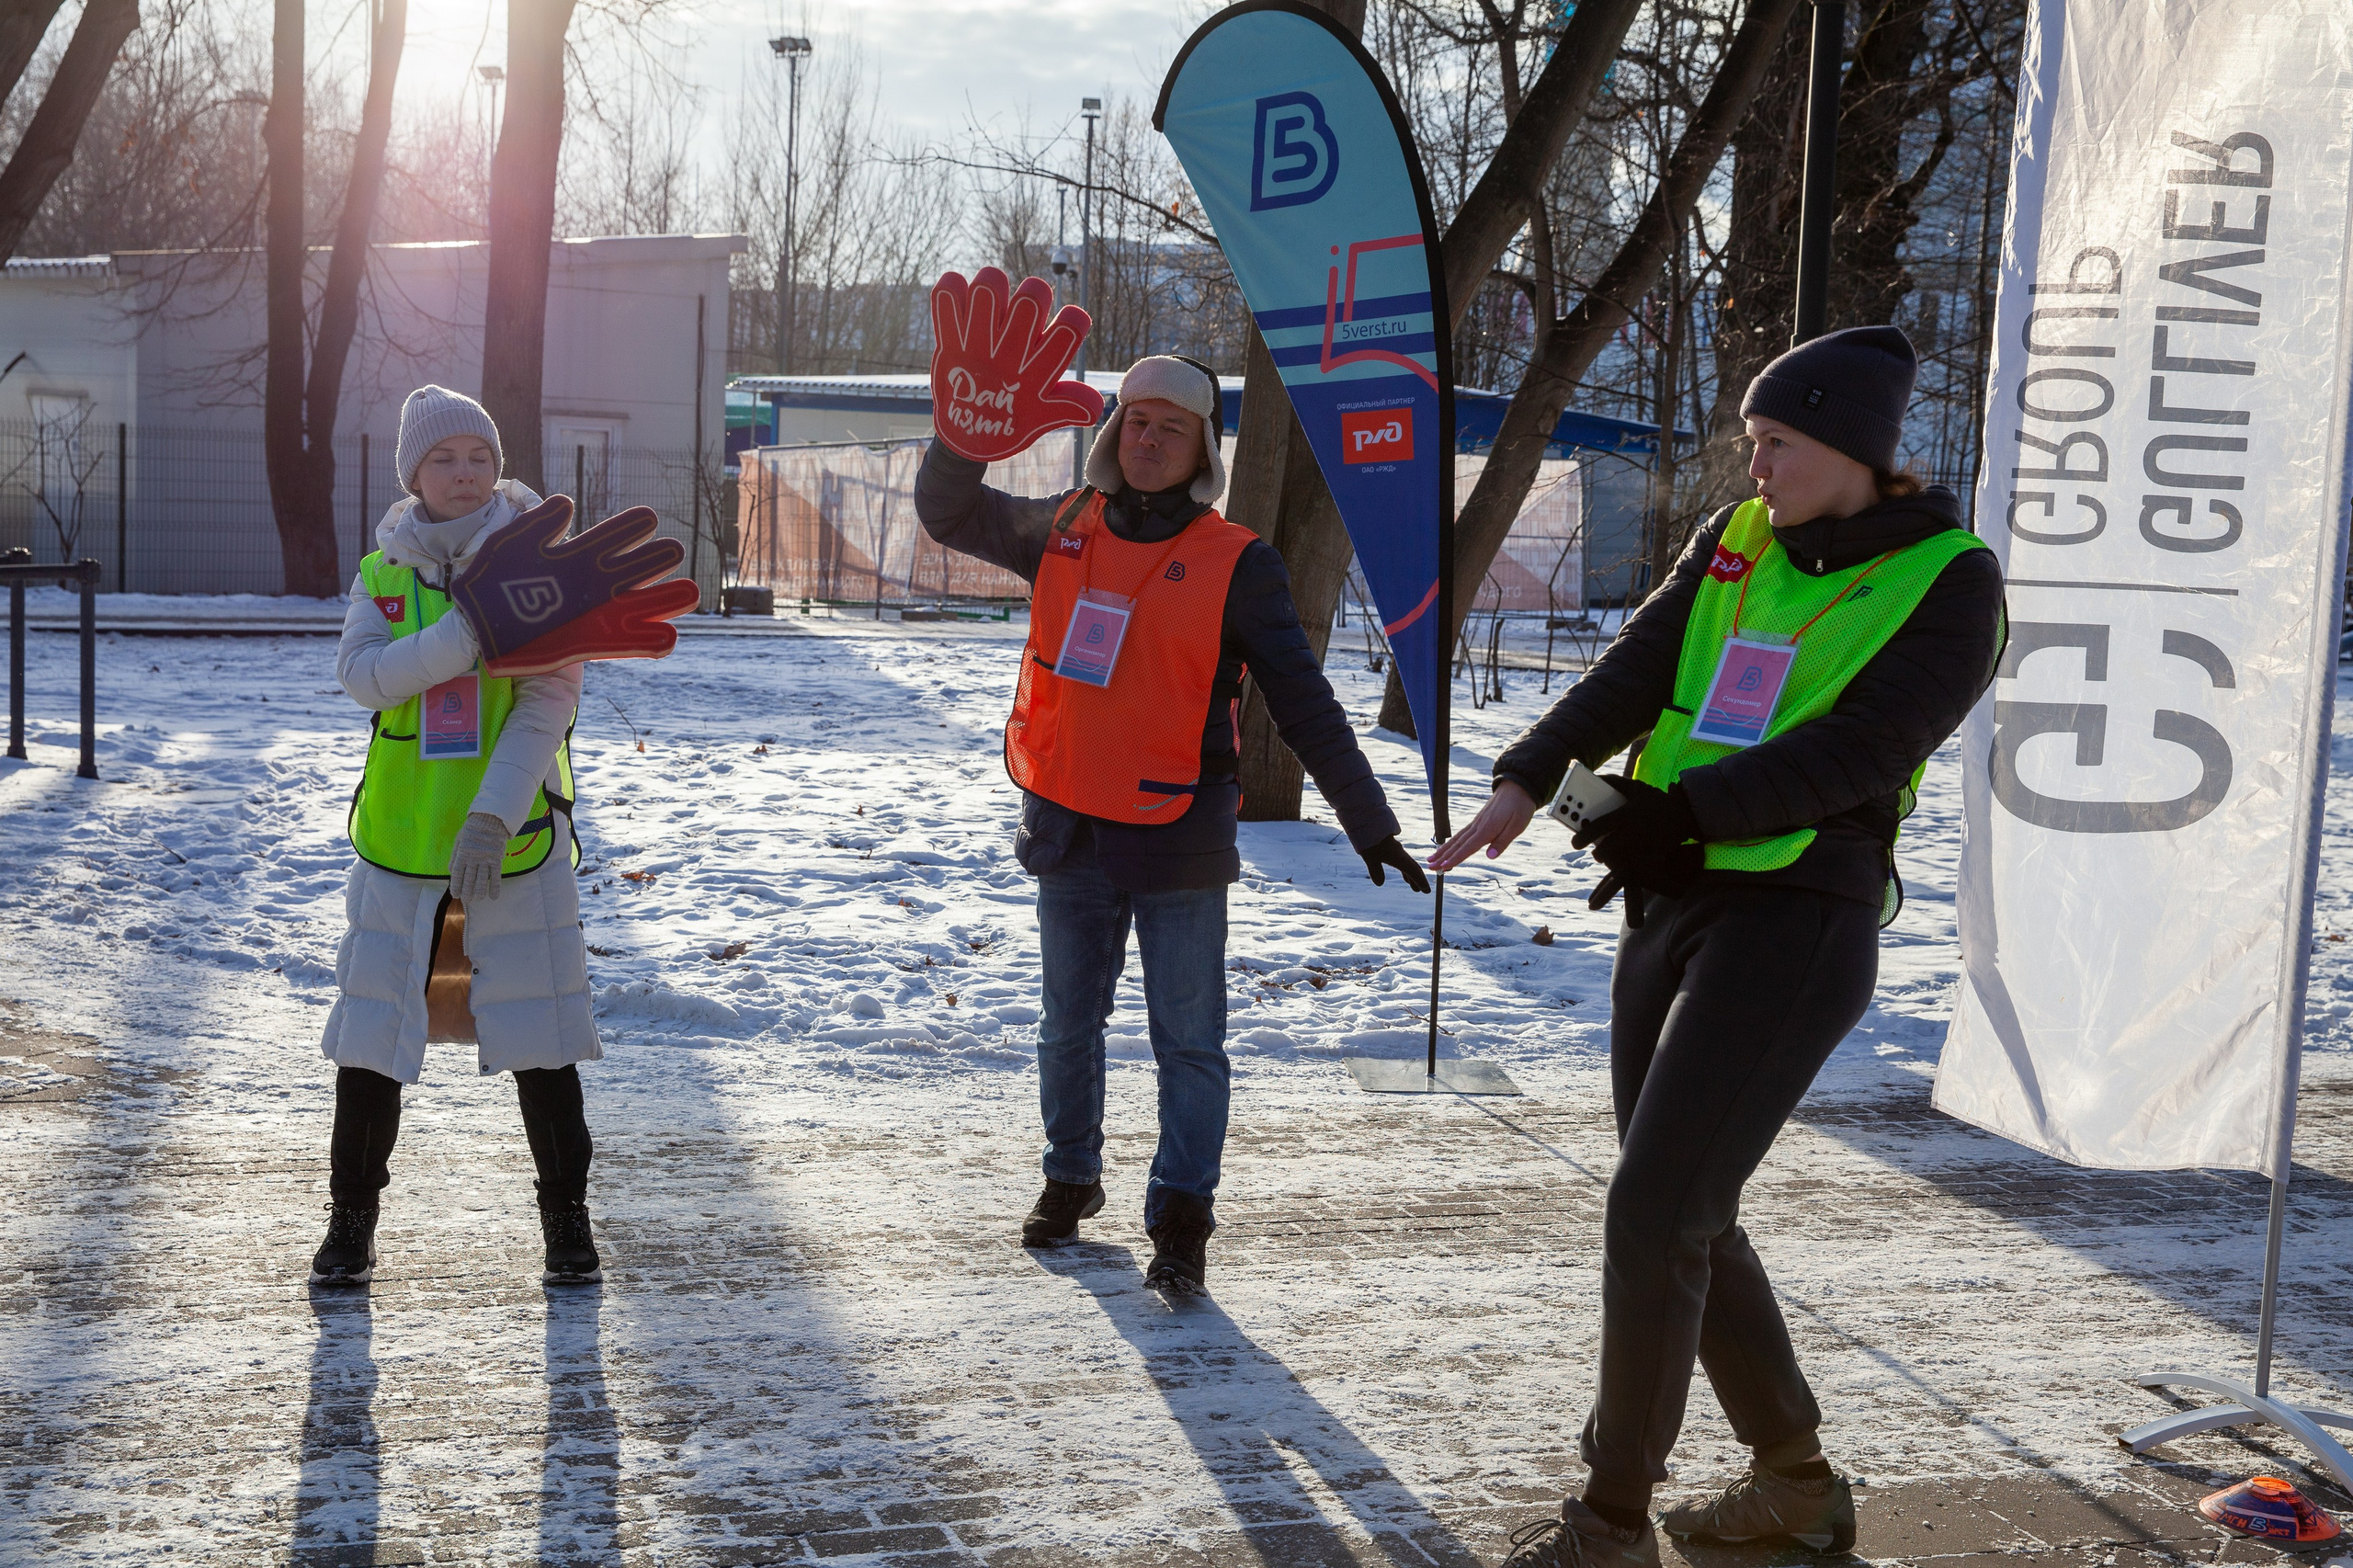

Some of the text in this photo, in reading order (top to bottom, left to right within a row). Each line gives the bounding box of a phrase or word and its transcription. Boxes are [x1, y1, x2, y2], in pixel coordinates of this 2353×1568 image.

[1342, 321, 1407, 339] 5verst.ru
[948, 367, 1020, 415] Дай
[1336, 397, 1415, 410] ОФИЦИАЛЬНЫЙ ПАРТНЕР
[948, 401, 1015, 436] пять
[1074, 645, 1106, 659] Организатор
[1722, 695, 1762, 708] Секундомер
[1621, 1551, 1645, 1562] MERRELL
